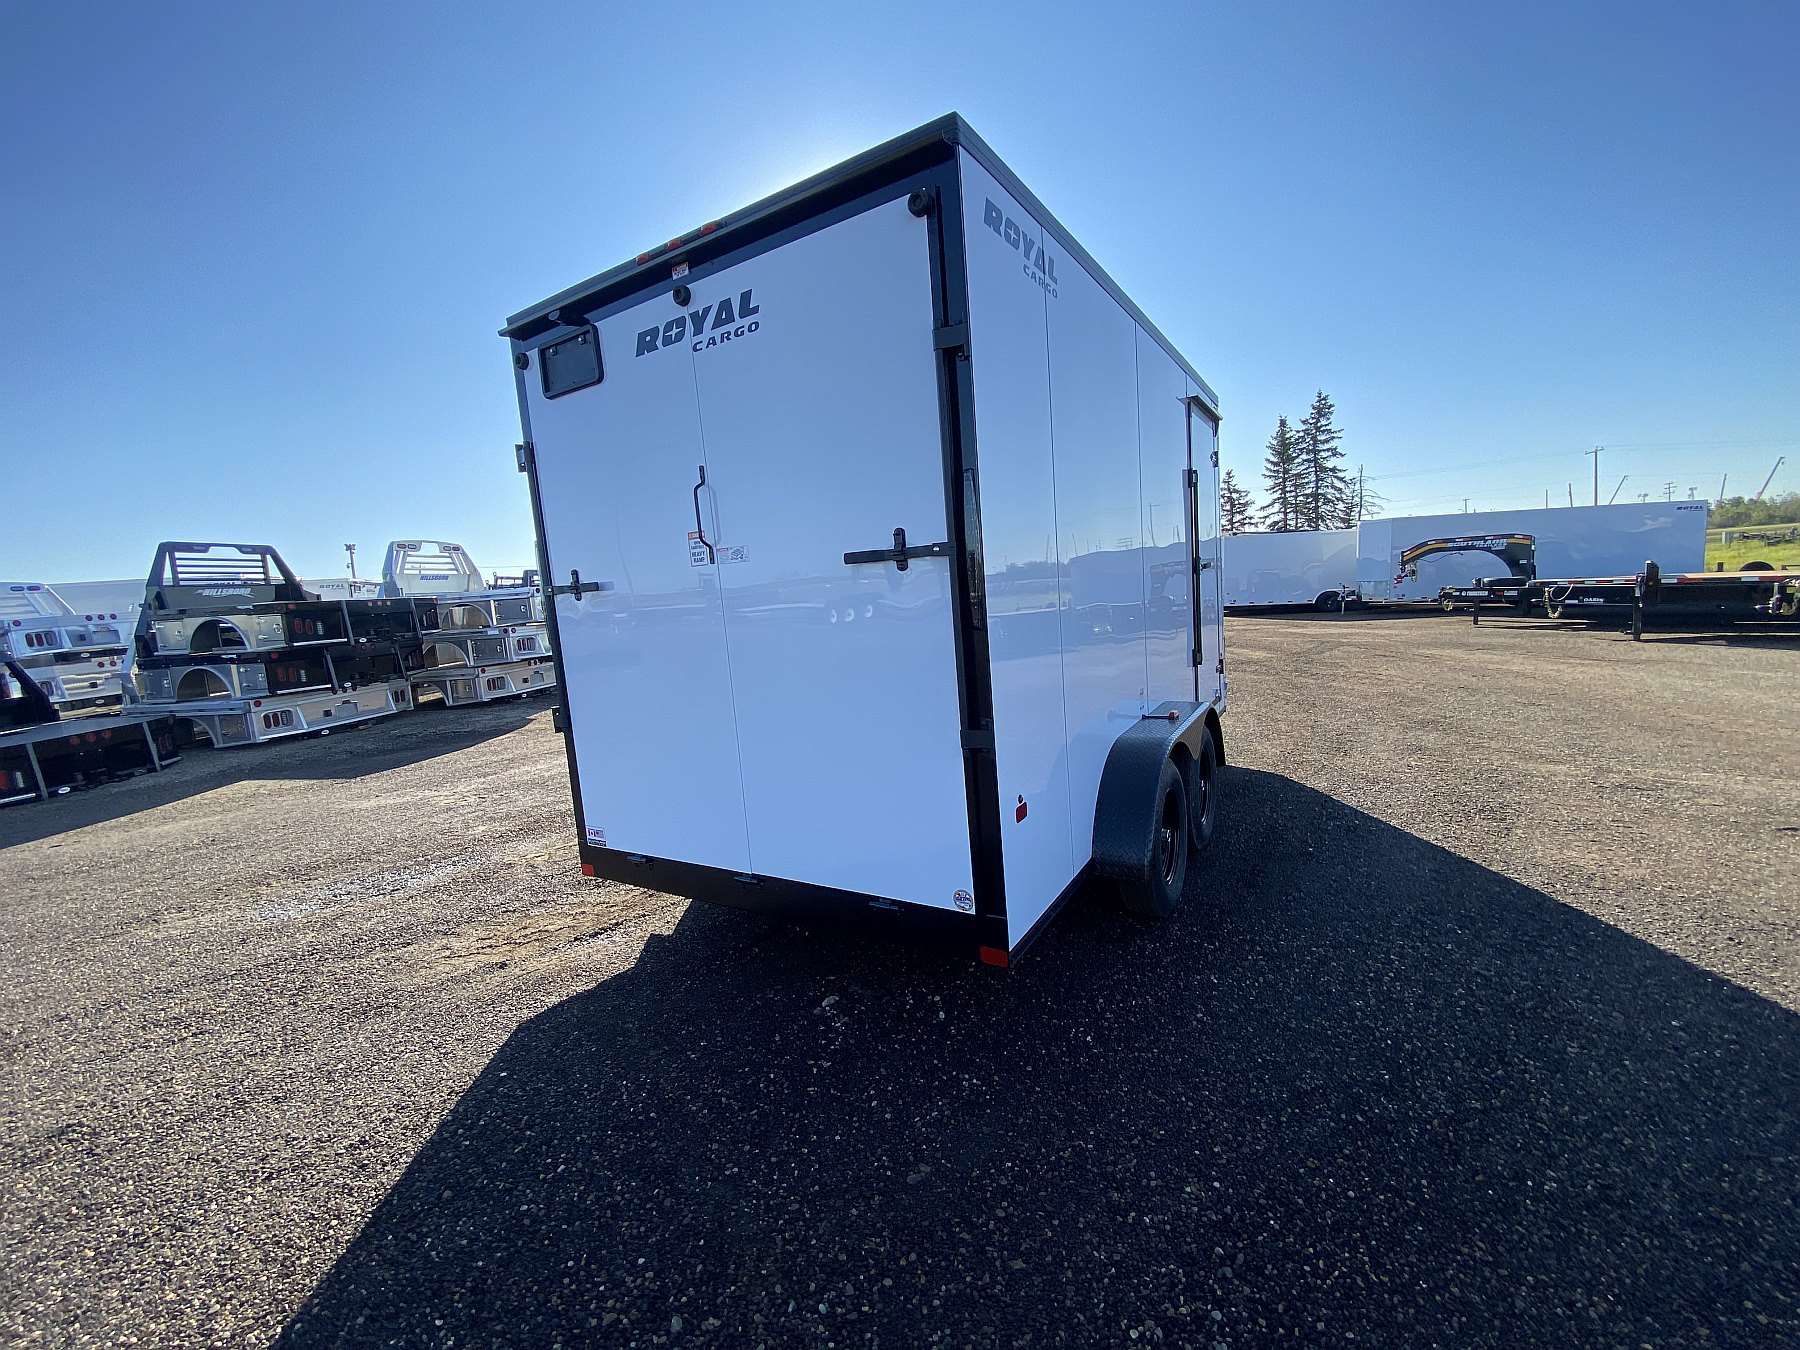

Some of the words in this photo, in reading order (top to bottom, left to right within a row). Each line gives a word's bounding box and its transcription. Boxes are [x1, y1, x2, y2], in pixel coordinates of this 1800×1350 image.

[984, 197, 1058, 286] ROYAL
[1023, 263, 1058, 299] CARGO
[635, 289, 760, 358] ROYAL
[692, 321, 760, 353] CARGO
